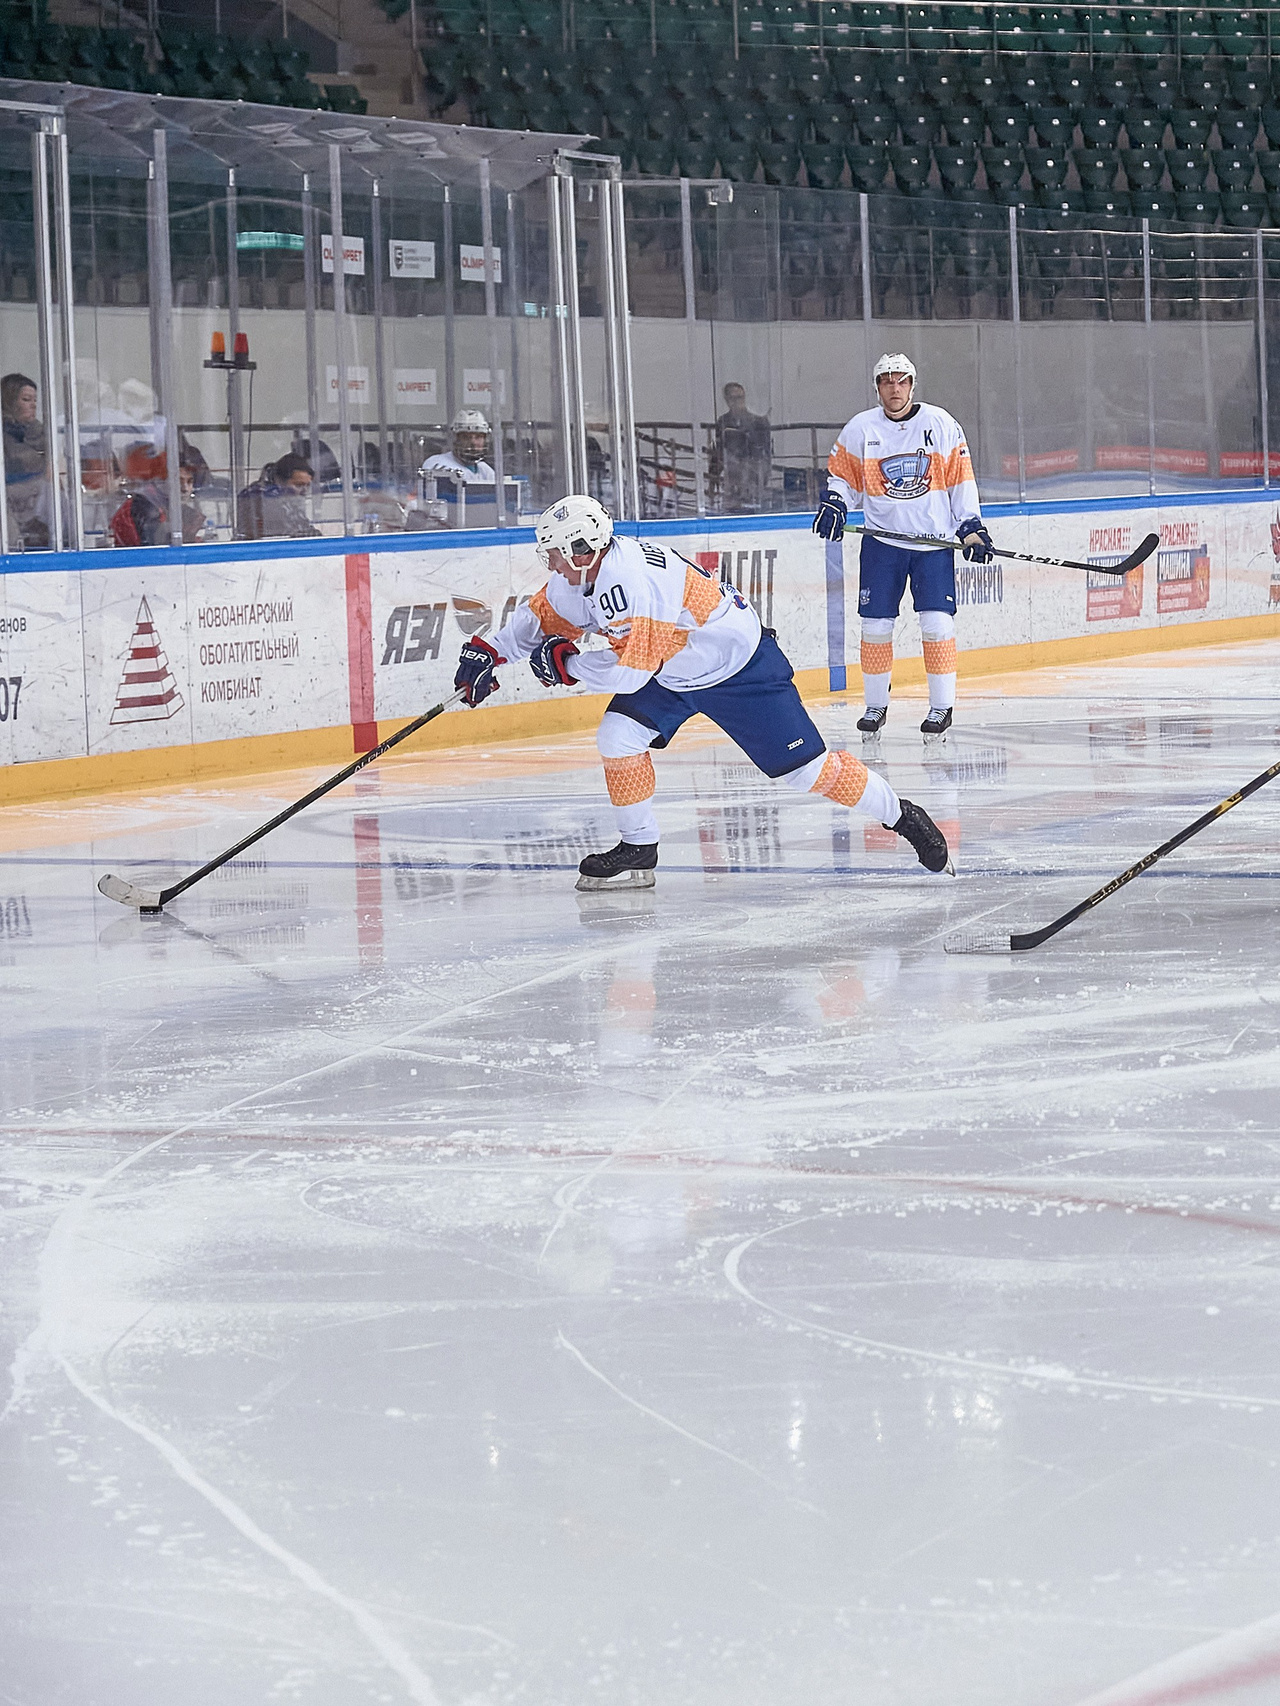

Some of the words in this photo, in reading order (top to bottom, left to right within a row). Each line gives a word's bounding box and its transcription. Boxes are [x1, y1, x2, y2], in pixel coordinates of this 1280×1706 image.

[323, 247, 363, 263] OLMPBET
[461, 256, 501, 271] OLIMPET
[1158, 552, 1192, 581] МАШИНА
[198, 597, 294, 629] НОВОАНГАРСКИЙ
[599, 583, 629, 621] 90
[199, 633, 300, 666] ОБОГАТИТЕЛЬНЫЙ
[461, 648, 489, 663] UER
[200, 676, 262, 703] КОМБИНАТ
